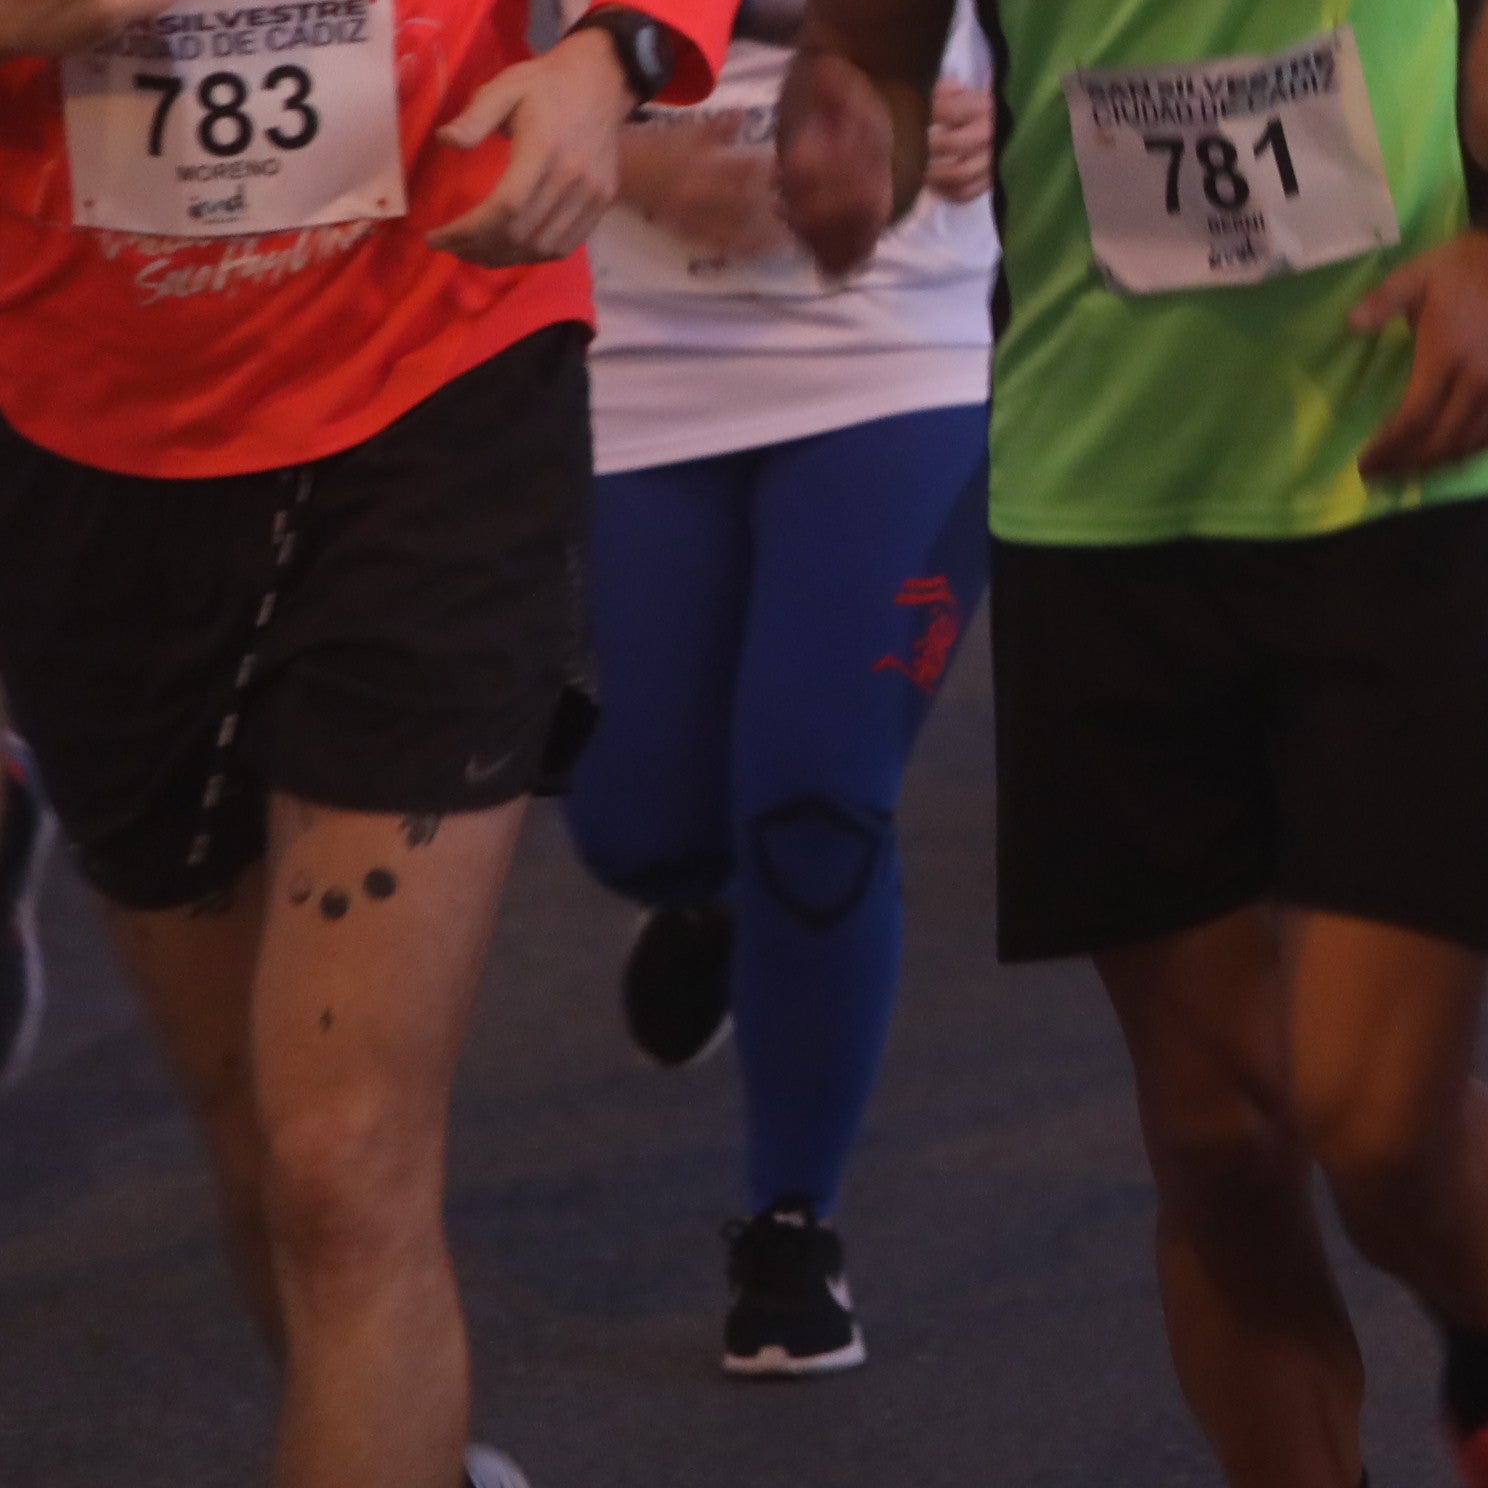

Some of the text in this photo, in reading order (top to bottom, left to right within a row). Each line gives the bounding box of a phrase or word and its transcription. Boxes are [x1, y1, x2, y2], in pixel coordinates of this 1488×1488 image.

[211, 28, 256, 58] DE
[133, 63, 319, 158] 783
[176, 158, 281, 183] MORENO
[1143, 115, 1300, 215] 781
